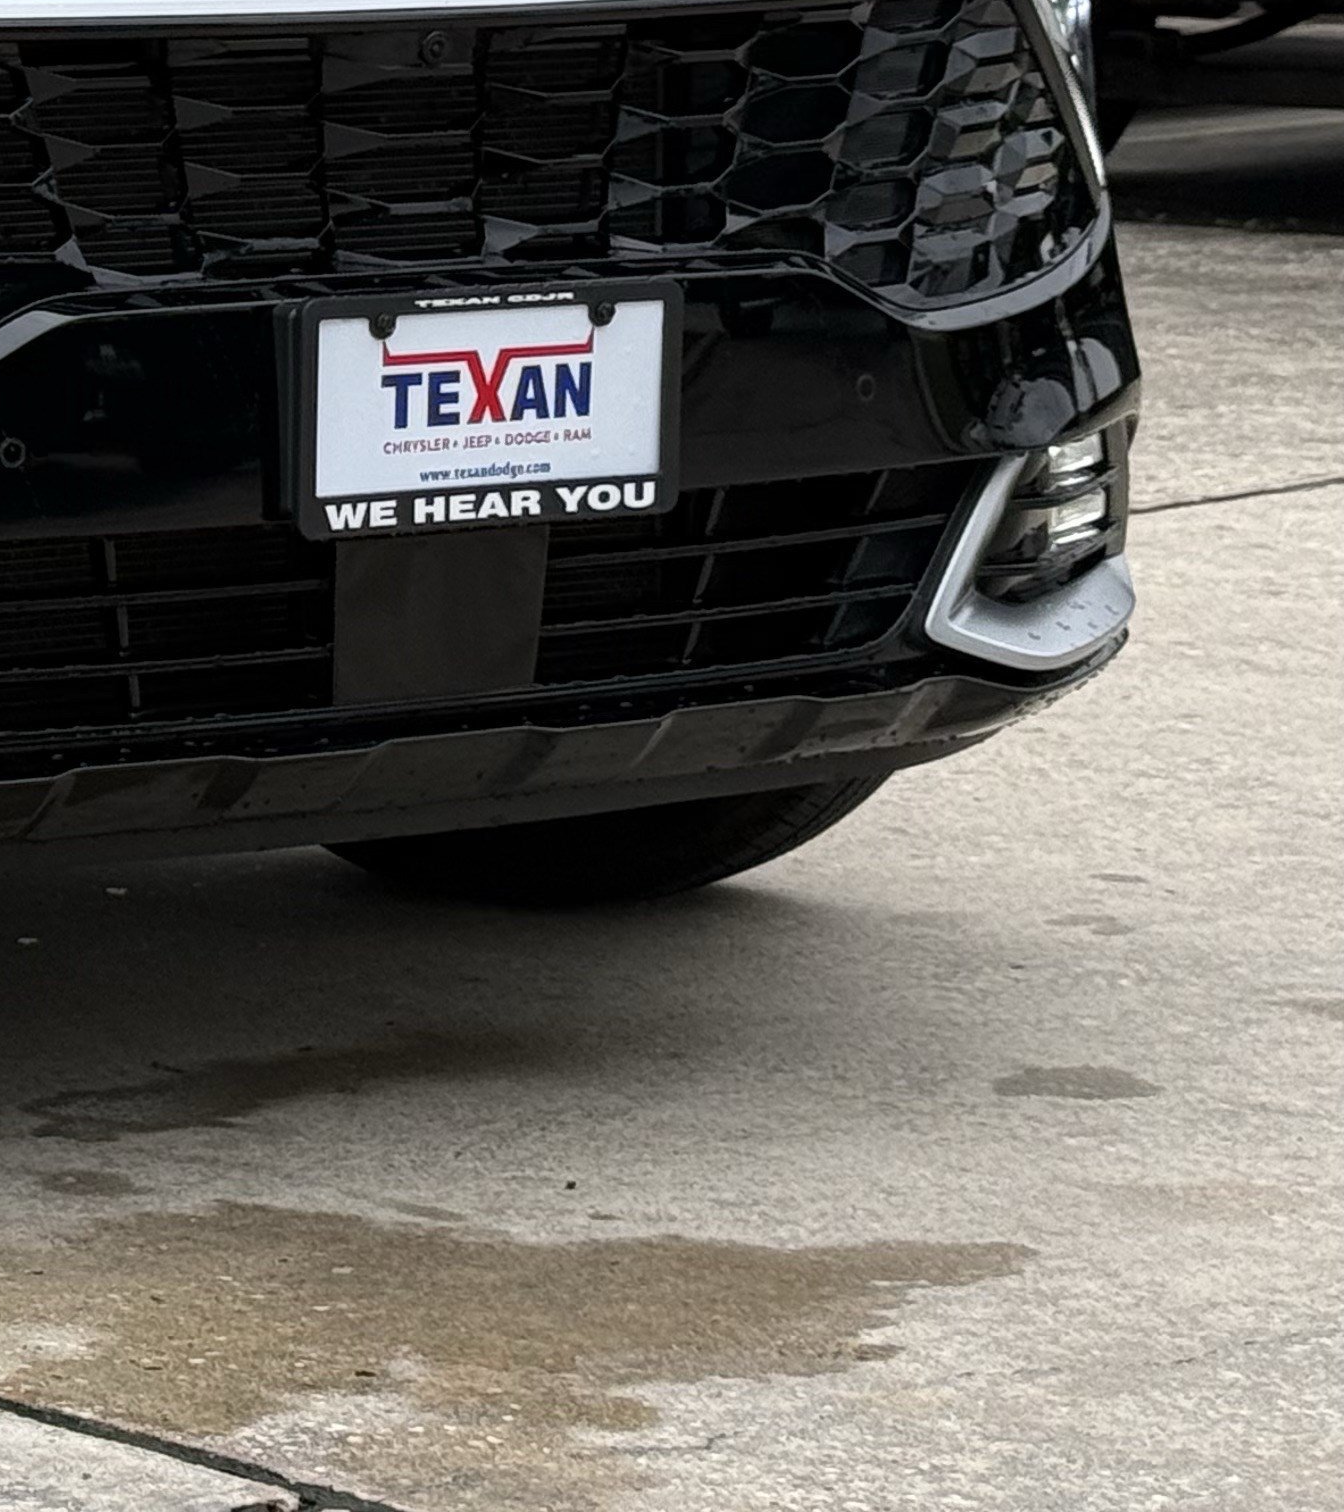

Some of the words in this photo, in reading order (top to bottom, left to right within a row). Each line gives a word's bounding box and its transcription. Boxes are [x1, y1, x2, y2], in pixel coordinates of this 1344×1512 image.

[414, 296, 501, 308] TEXAN
[380, 344, 594, 429] TEXAN
[383, 438, 450, 455] CHRYSLER
[463, 434, 492, 449] JEEP
[504, 431, 551, 446] DODGE
[563, 428, 592, 442] RAM
[420, 461, 551, 482] www.texandodge.com
[325, 499, 398, 531] WE
[414, 489, 542, 525] HEAR
[556, 481, 656, 514] YOU
